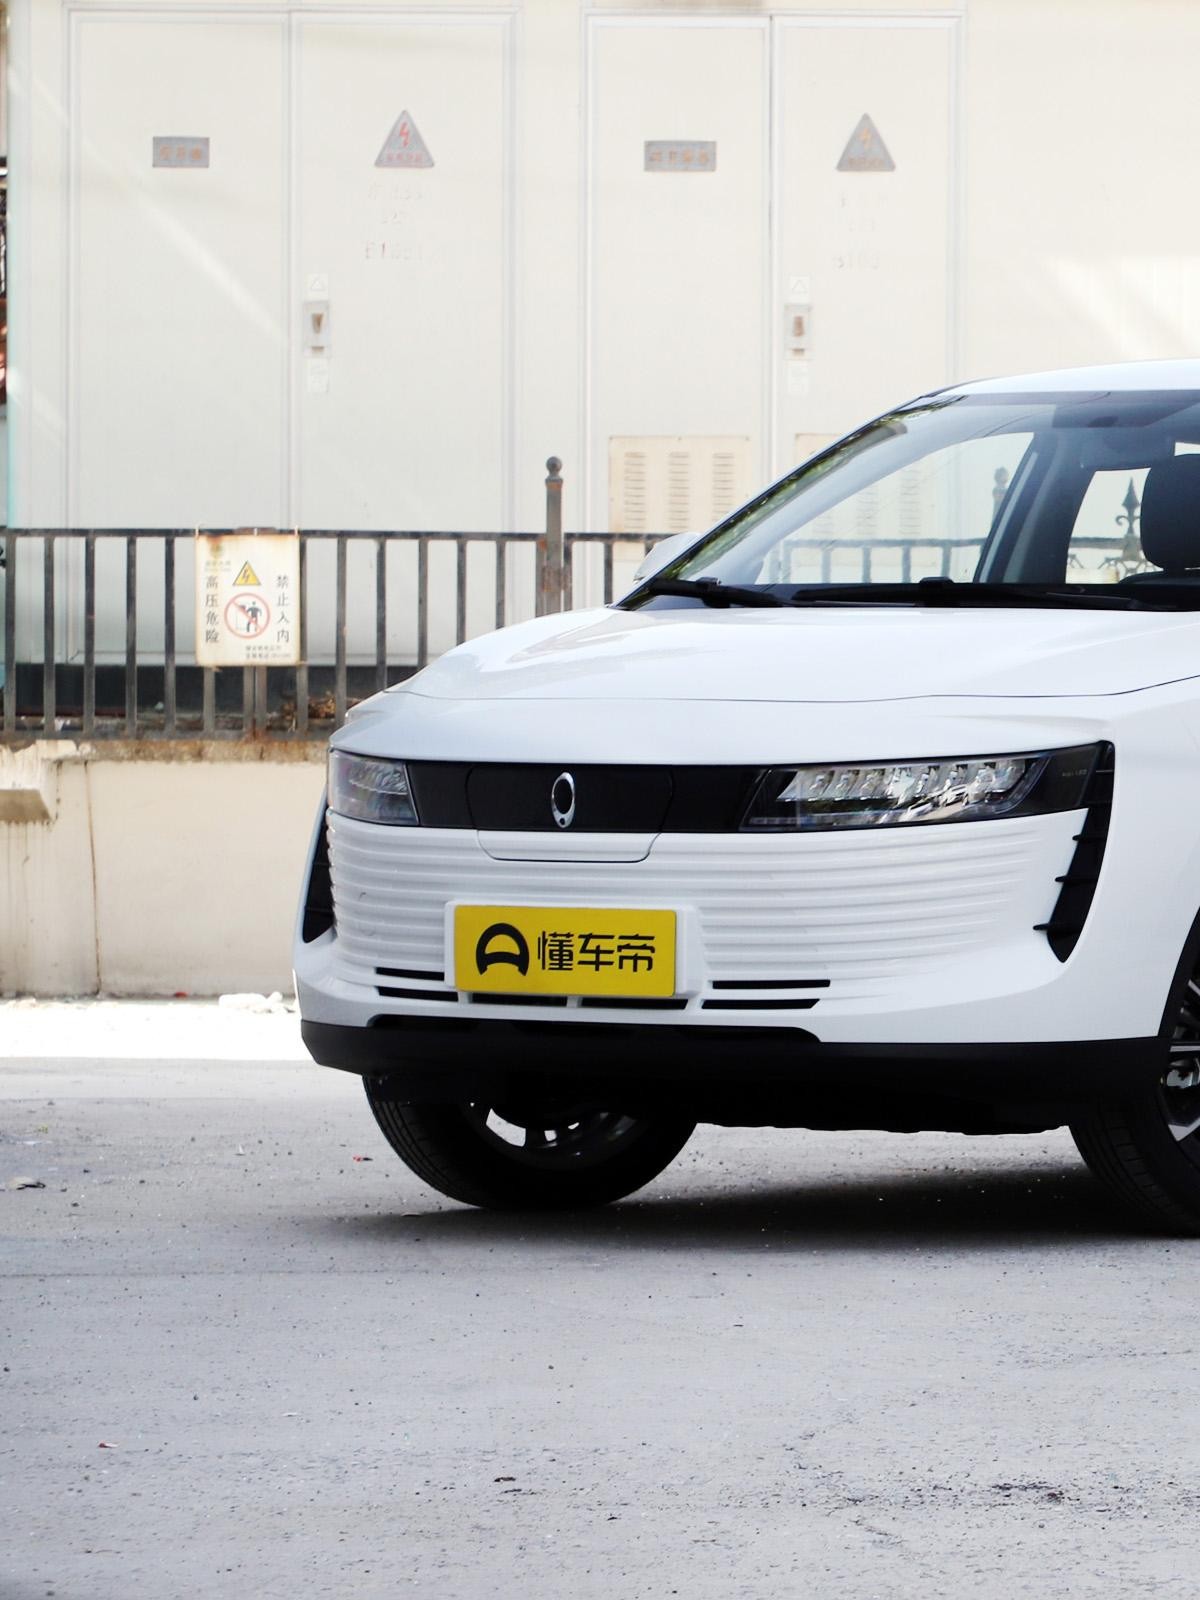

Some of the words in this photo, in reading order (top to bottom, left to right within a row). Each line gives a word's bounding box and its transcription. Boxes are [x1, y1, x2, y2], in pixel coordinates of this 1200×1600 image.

[205, 575, 219, 643] 高压危险
[277, 575, 290, 643] 禁止入内
[537, 931, 656, 972] 懂车帝
